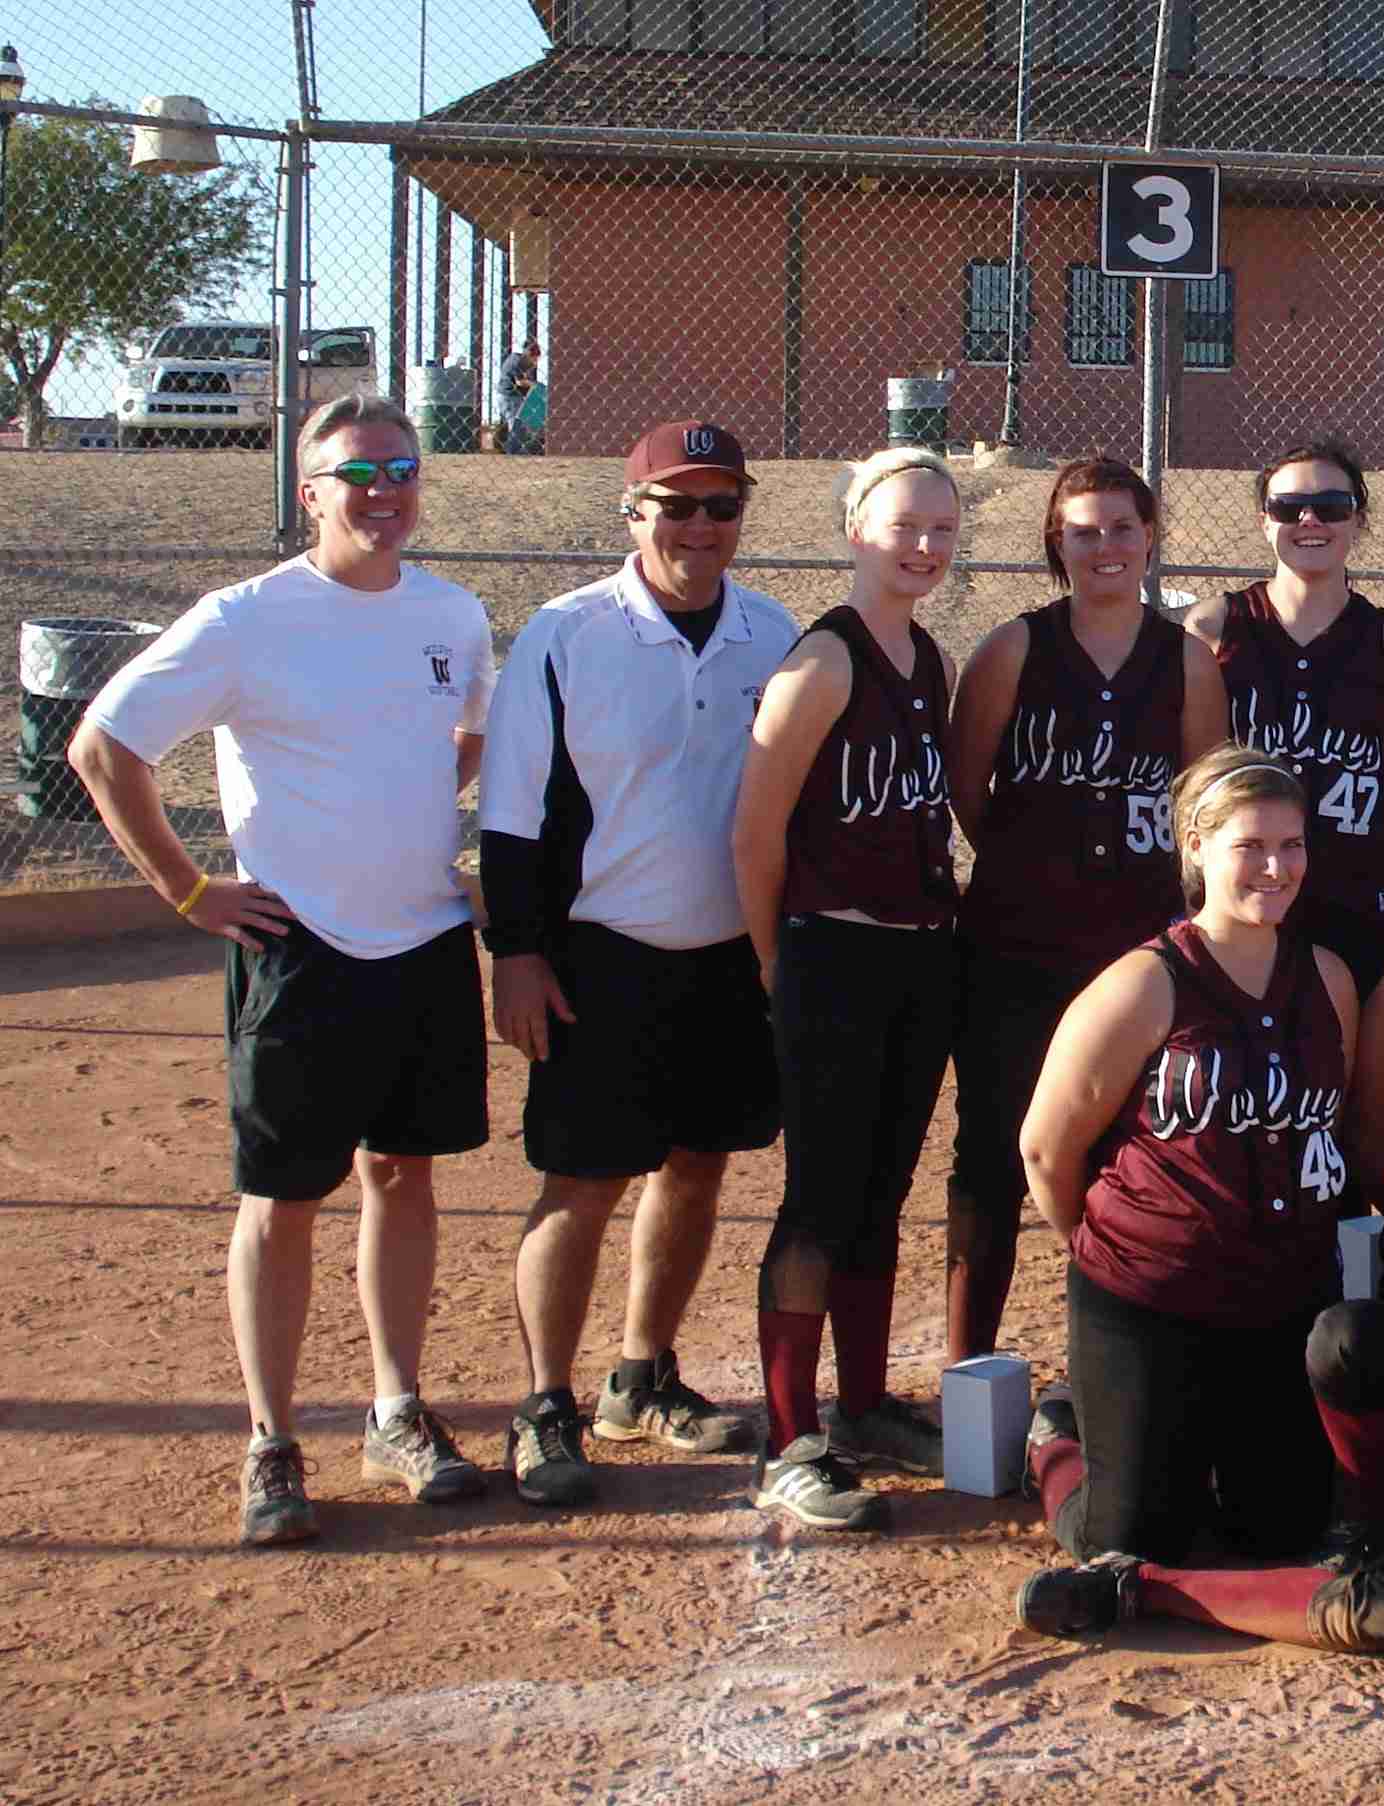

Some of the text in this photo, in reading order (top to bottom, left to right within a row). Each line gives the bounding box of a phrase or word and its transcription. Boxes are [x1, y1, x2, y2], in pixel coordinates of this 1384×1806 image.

[1125, 174, 1194, 263] 3
[683, 428, 715, 456] W
[1125, 793, 1178, 855] 58
[1317, 771, 1380, 836] 47
